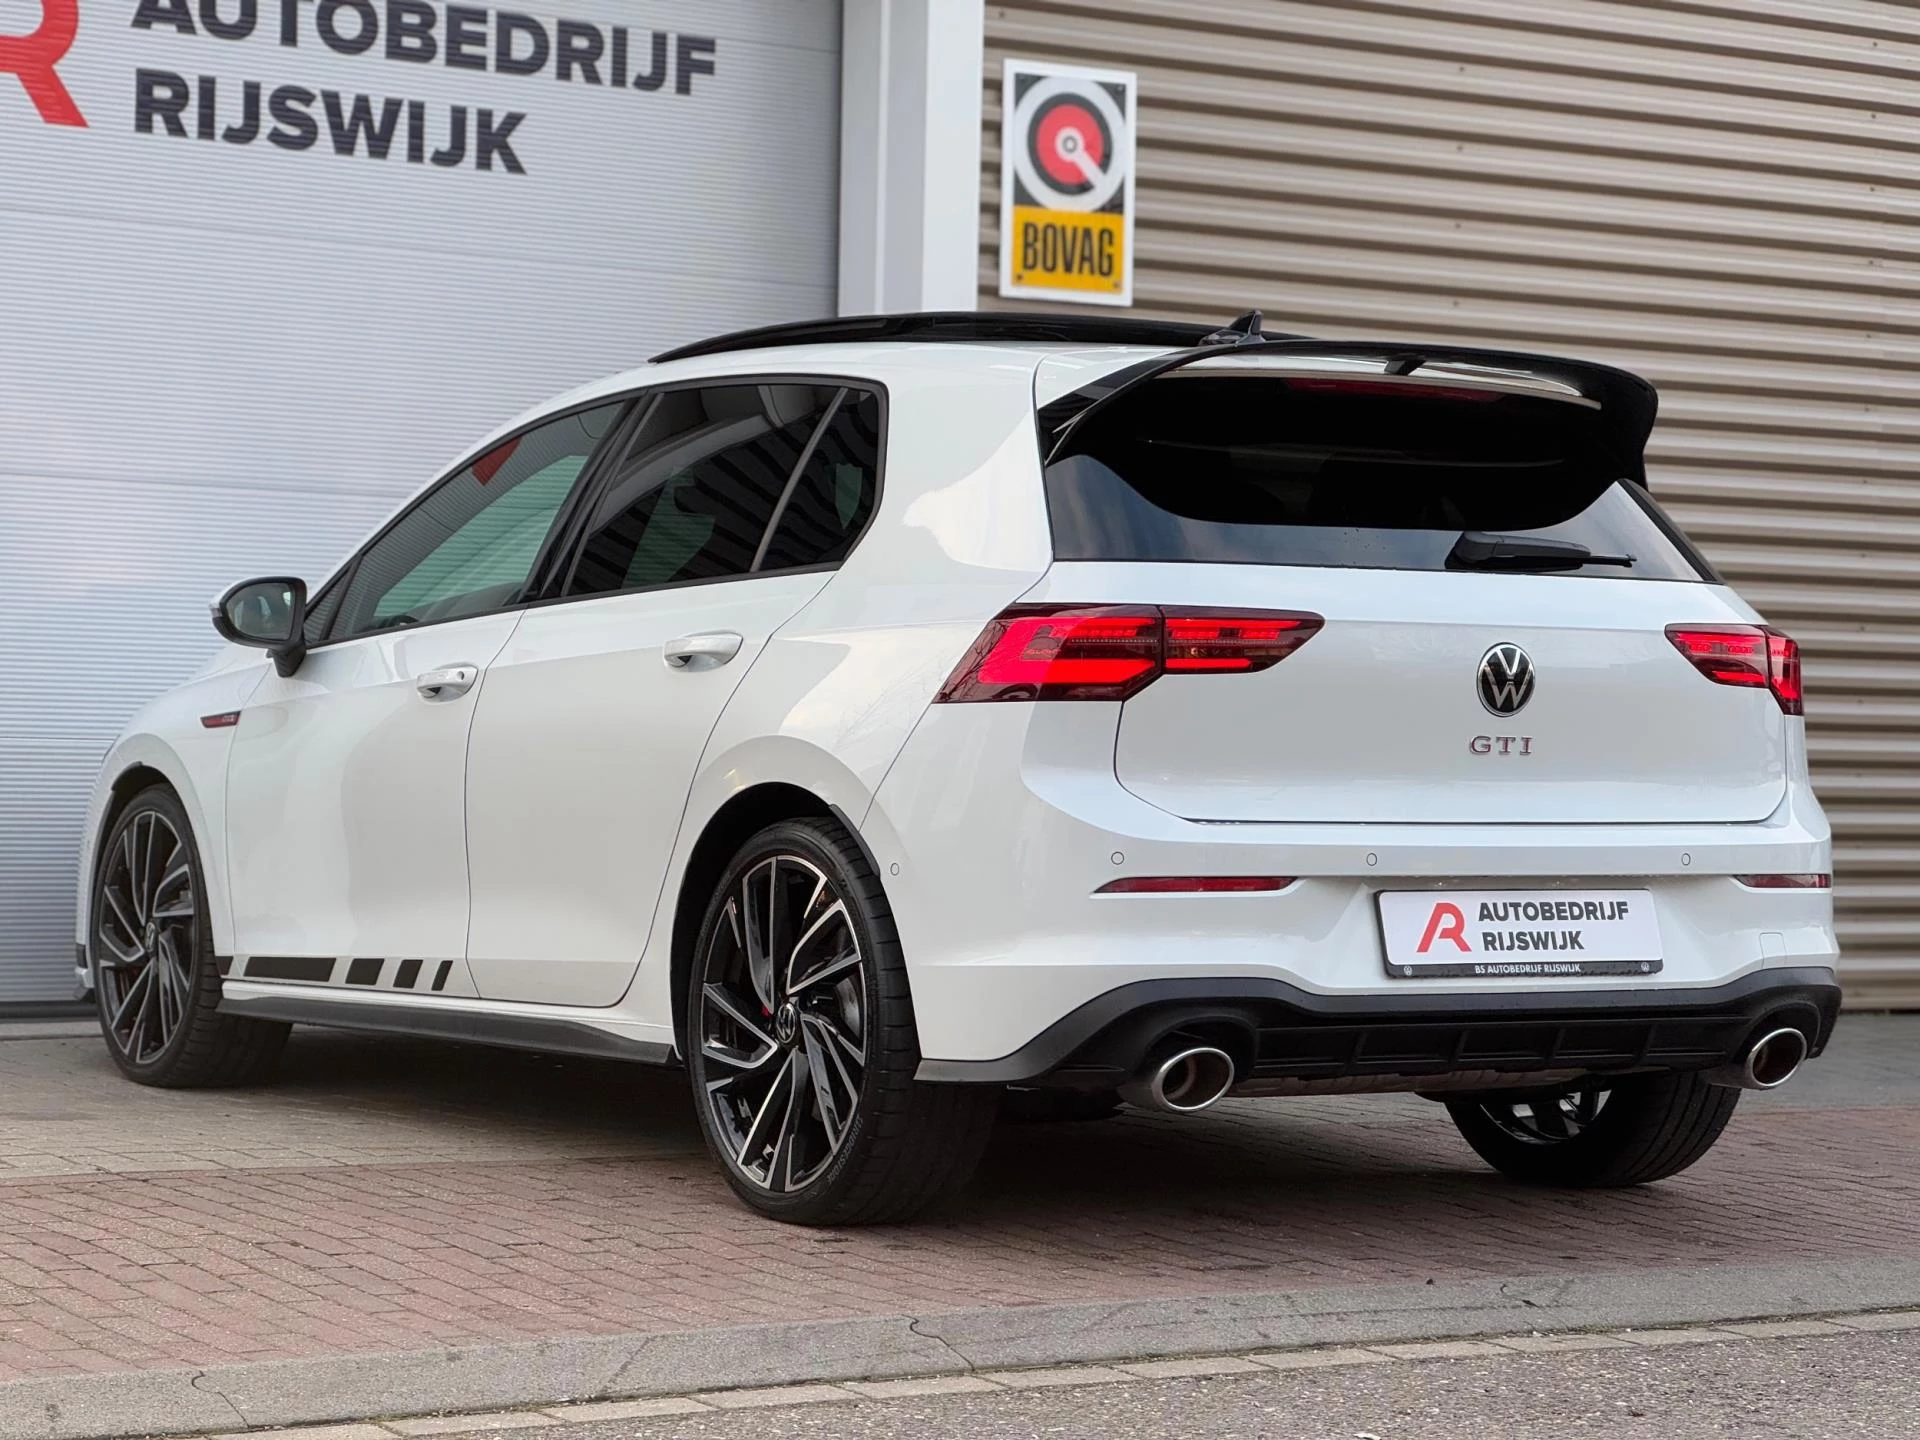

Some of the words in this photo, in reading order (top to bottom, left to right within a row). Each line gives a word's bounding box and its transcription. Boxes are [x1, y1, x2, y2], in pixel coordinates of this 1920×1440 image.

[135, 67, 528, 175] RIJSWIJK
[1022, 221, 1114, 278] BOVAG
[1469, 735, 1533, 755] GTI
[1478, 901, 1629, 922] AUTOBEDRIJF
[1482, 930, 1585, 951] RIJSWIJK
[1474, 964, 1485, 974] BS
[1487, 963, 1542, 974] AUTOBEDRIJF
[1543, 963, 1581, 973] RIJSWIJK
